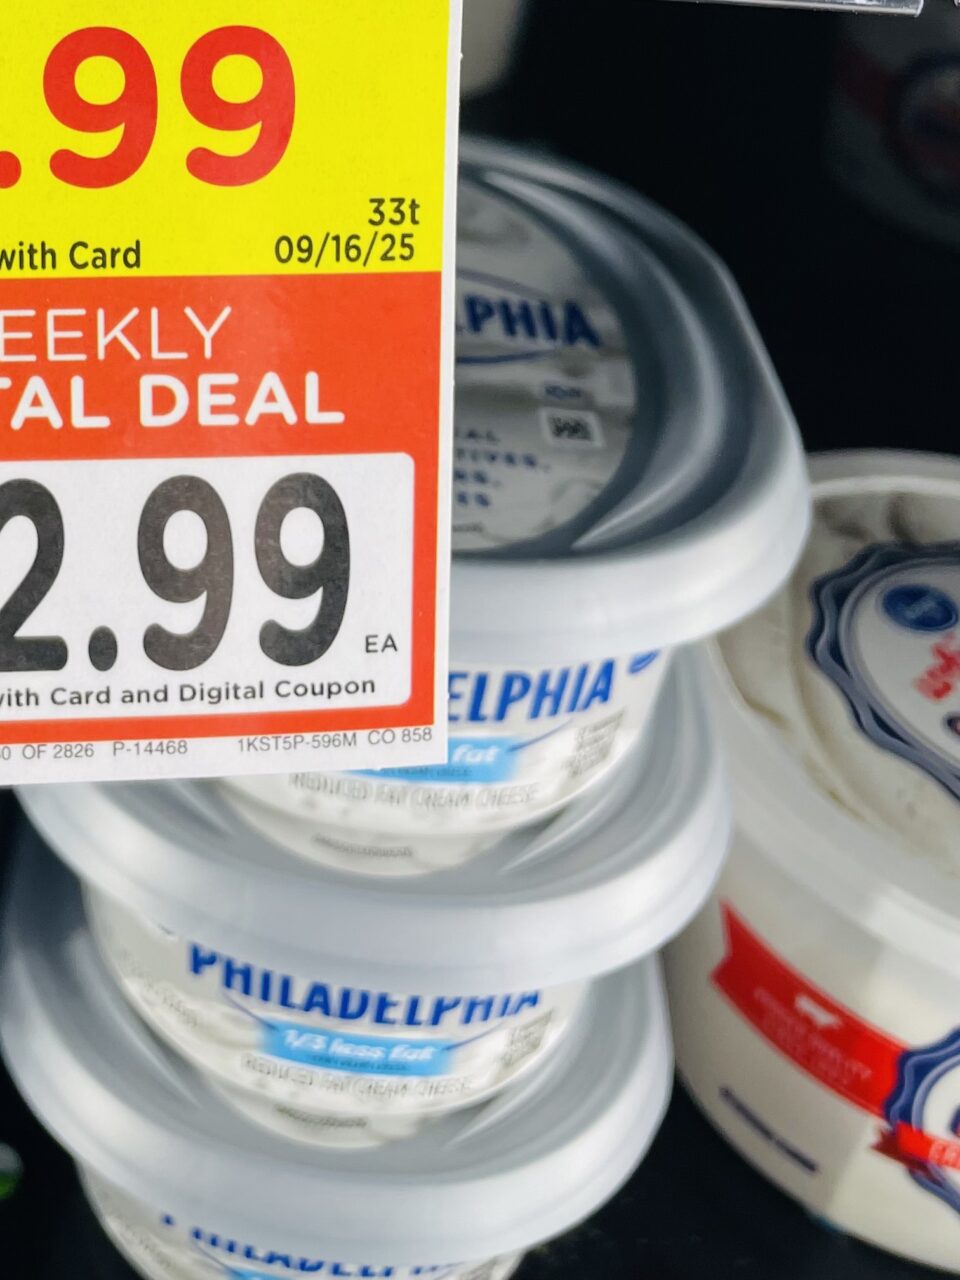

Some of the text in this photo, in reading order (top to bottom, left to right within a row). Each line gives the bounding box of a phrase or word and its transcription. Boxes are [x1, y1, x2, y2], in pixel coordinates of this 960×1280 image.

[367, 197, 422, 228] 33t
[68, 239, 142, 271] Card
[273, 231, 417, 266] 09/16/25
[456, 294, 604, 349] PHIA
[139, 370, 347, 428] DEAL
[364, 634, 399, 655] EA
[49, 684, 113, 707] Card
[121, 682, 169, 705] and
[177, 678, 266, 711] Digital
[272, 676, 377, 707] Coupon
[21, 744, 48, 760] OF
[52, 742, 95, 759] 2826
[112, 739, 189, 757] P-14468
[237, 732, 358, 753] 1KST5P-596M
[367, 729, 396, 746] CO
[401, 727, 434, 743] 858
[451, 743, 501, 764] fat
